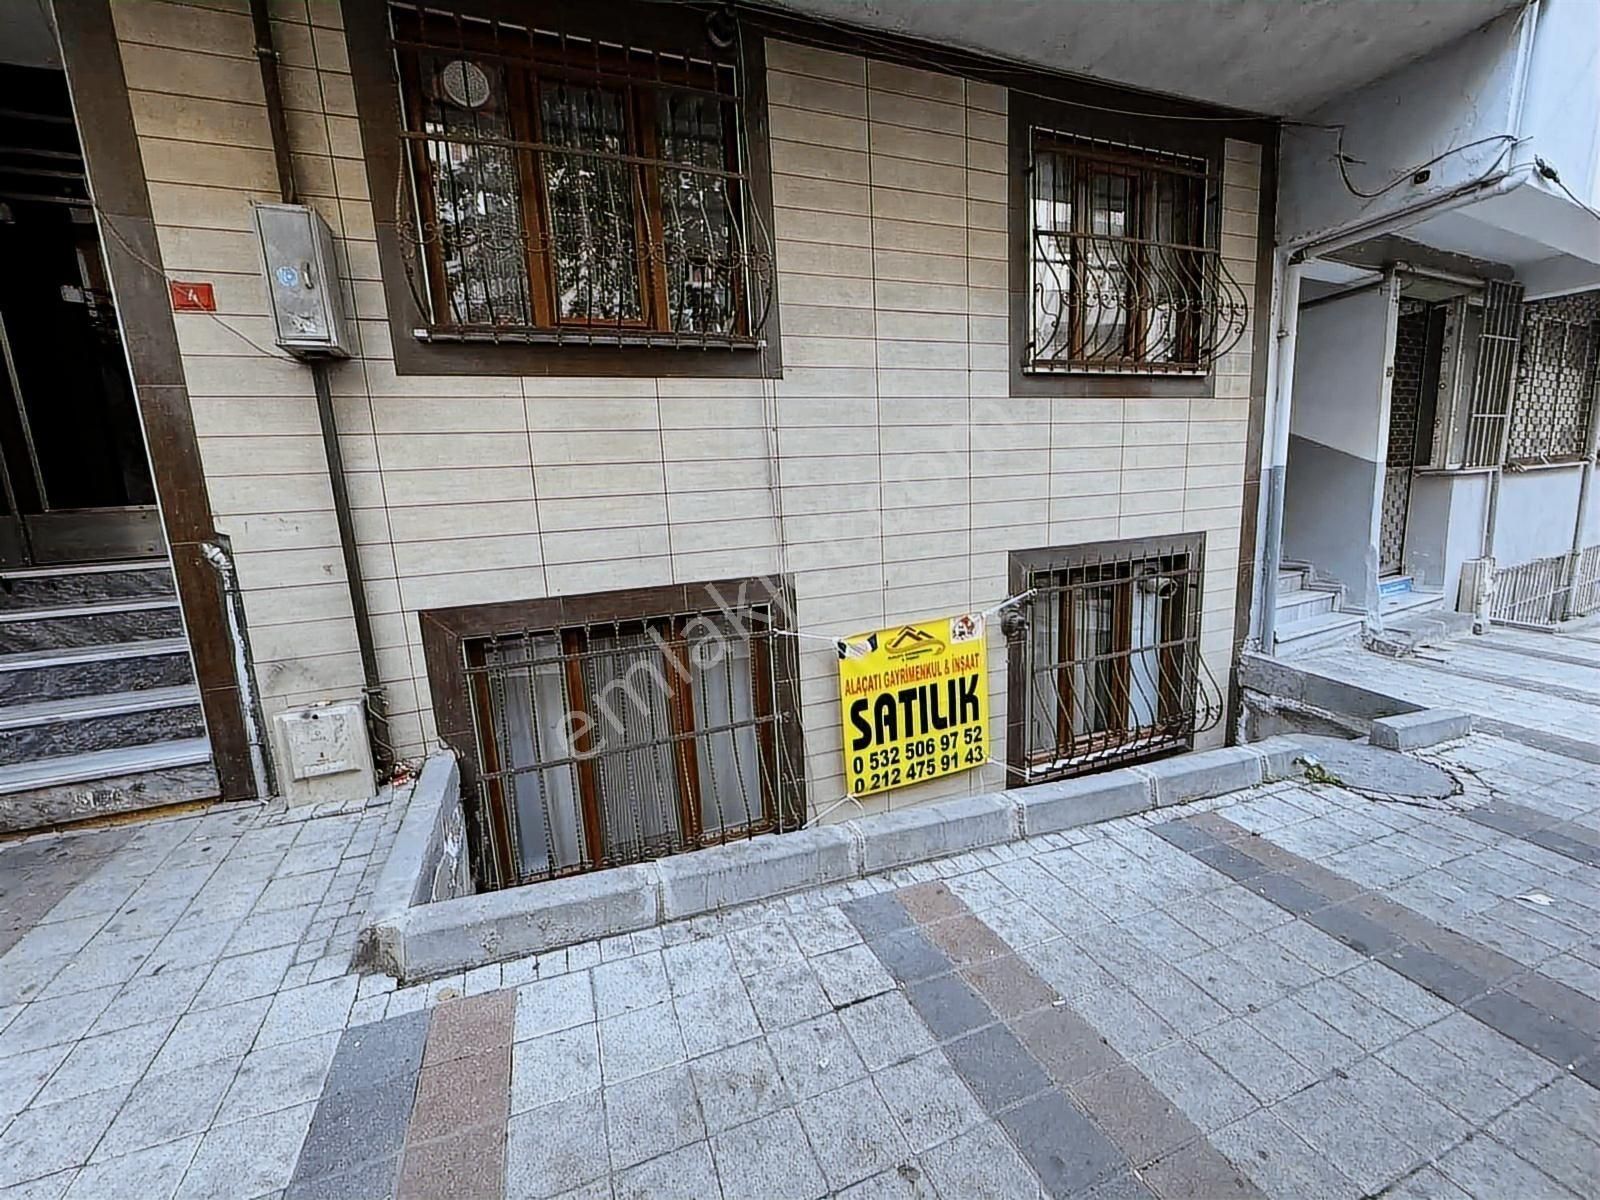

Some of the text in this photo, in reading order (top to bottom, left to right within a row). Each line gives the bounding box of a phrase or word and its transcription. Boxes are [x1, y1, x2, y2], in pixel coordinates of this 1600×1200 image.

[845, 673, 882, 696] ALAÇATI
[884, 661, 942, 689] GAYRİMENKUL
[944, 661, 950, 675] &
[952, 653, 980, 676] İNŞAAT
[850, 674, 980, 751] SATILIK
[853, 726, 982, 774] 0 532 506 97 52
[854, 746, 984, 794] 0 212 475 91 43
